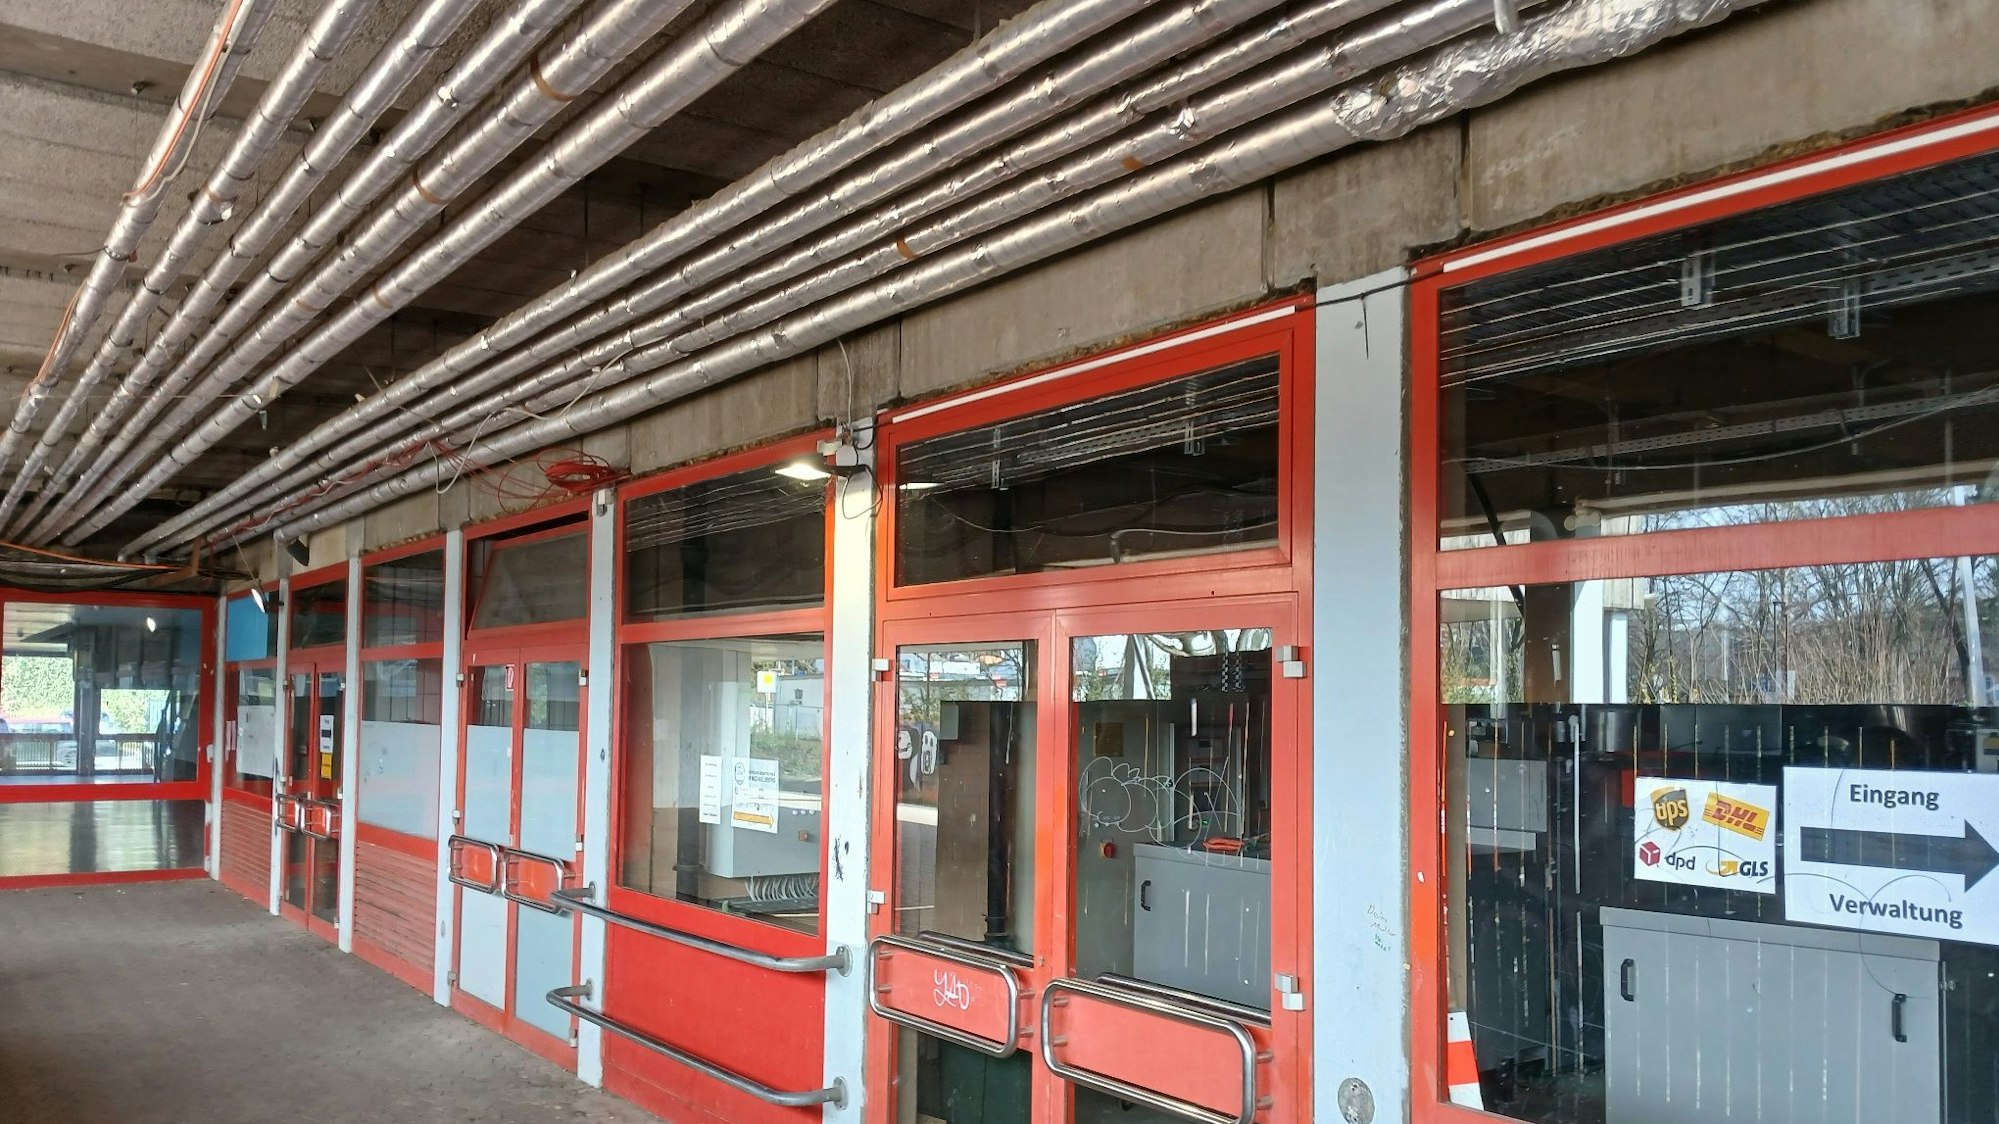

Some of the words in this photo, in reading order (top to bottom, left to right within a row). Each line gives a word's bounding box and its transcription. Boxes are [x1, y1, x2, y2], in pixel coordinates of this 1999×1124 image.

[1849, 784, 1940, 811] Eingang
[1655, 799, 1688, 826] ups
[1711, 800, 1758, 832] DHL
[1665, 851, 1696, 870] dpd
[1739, 860, 1769, 877] GLS
[1828, 893, 1964, 930] Verwaltung
